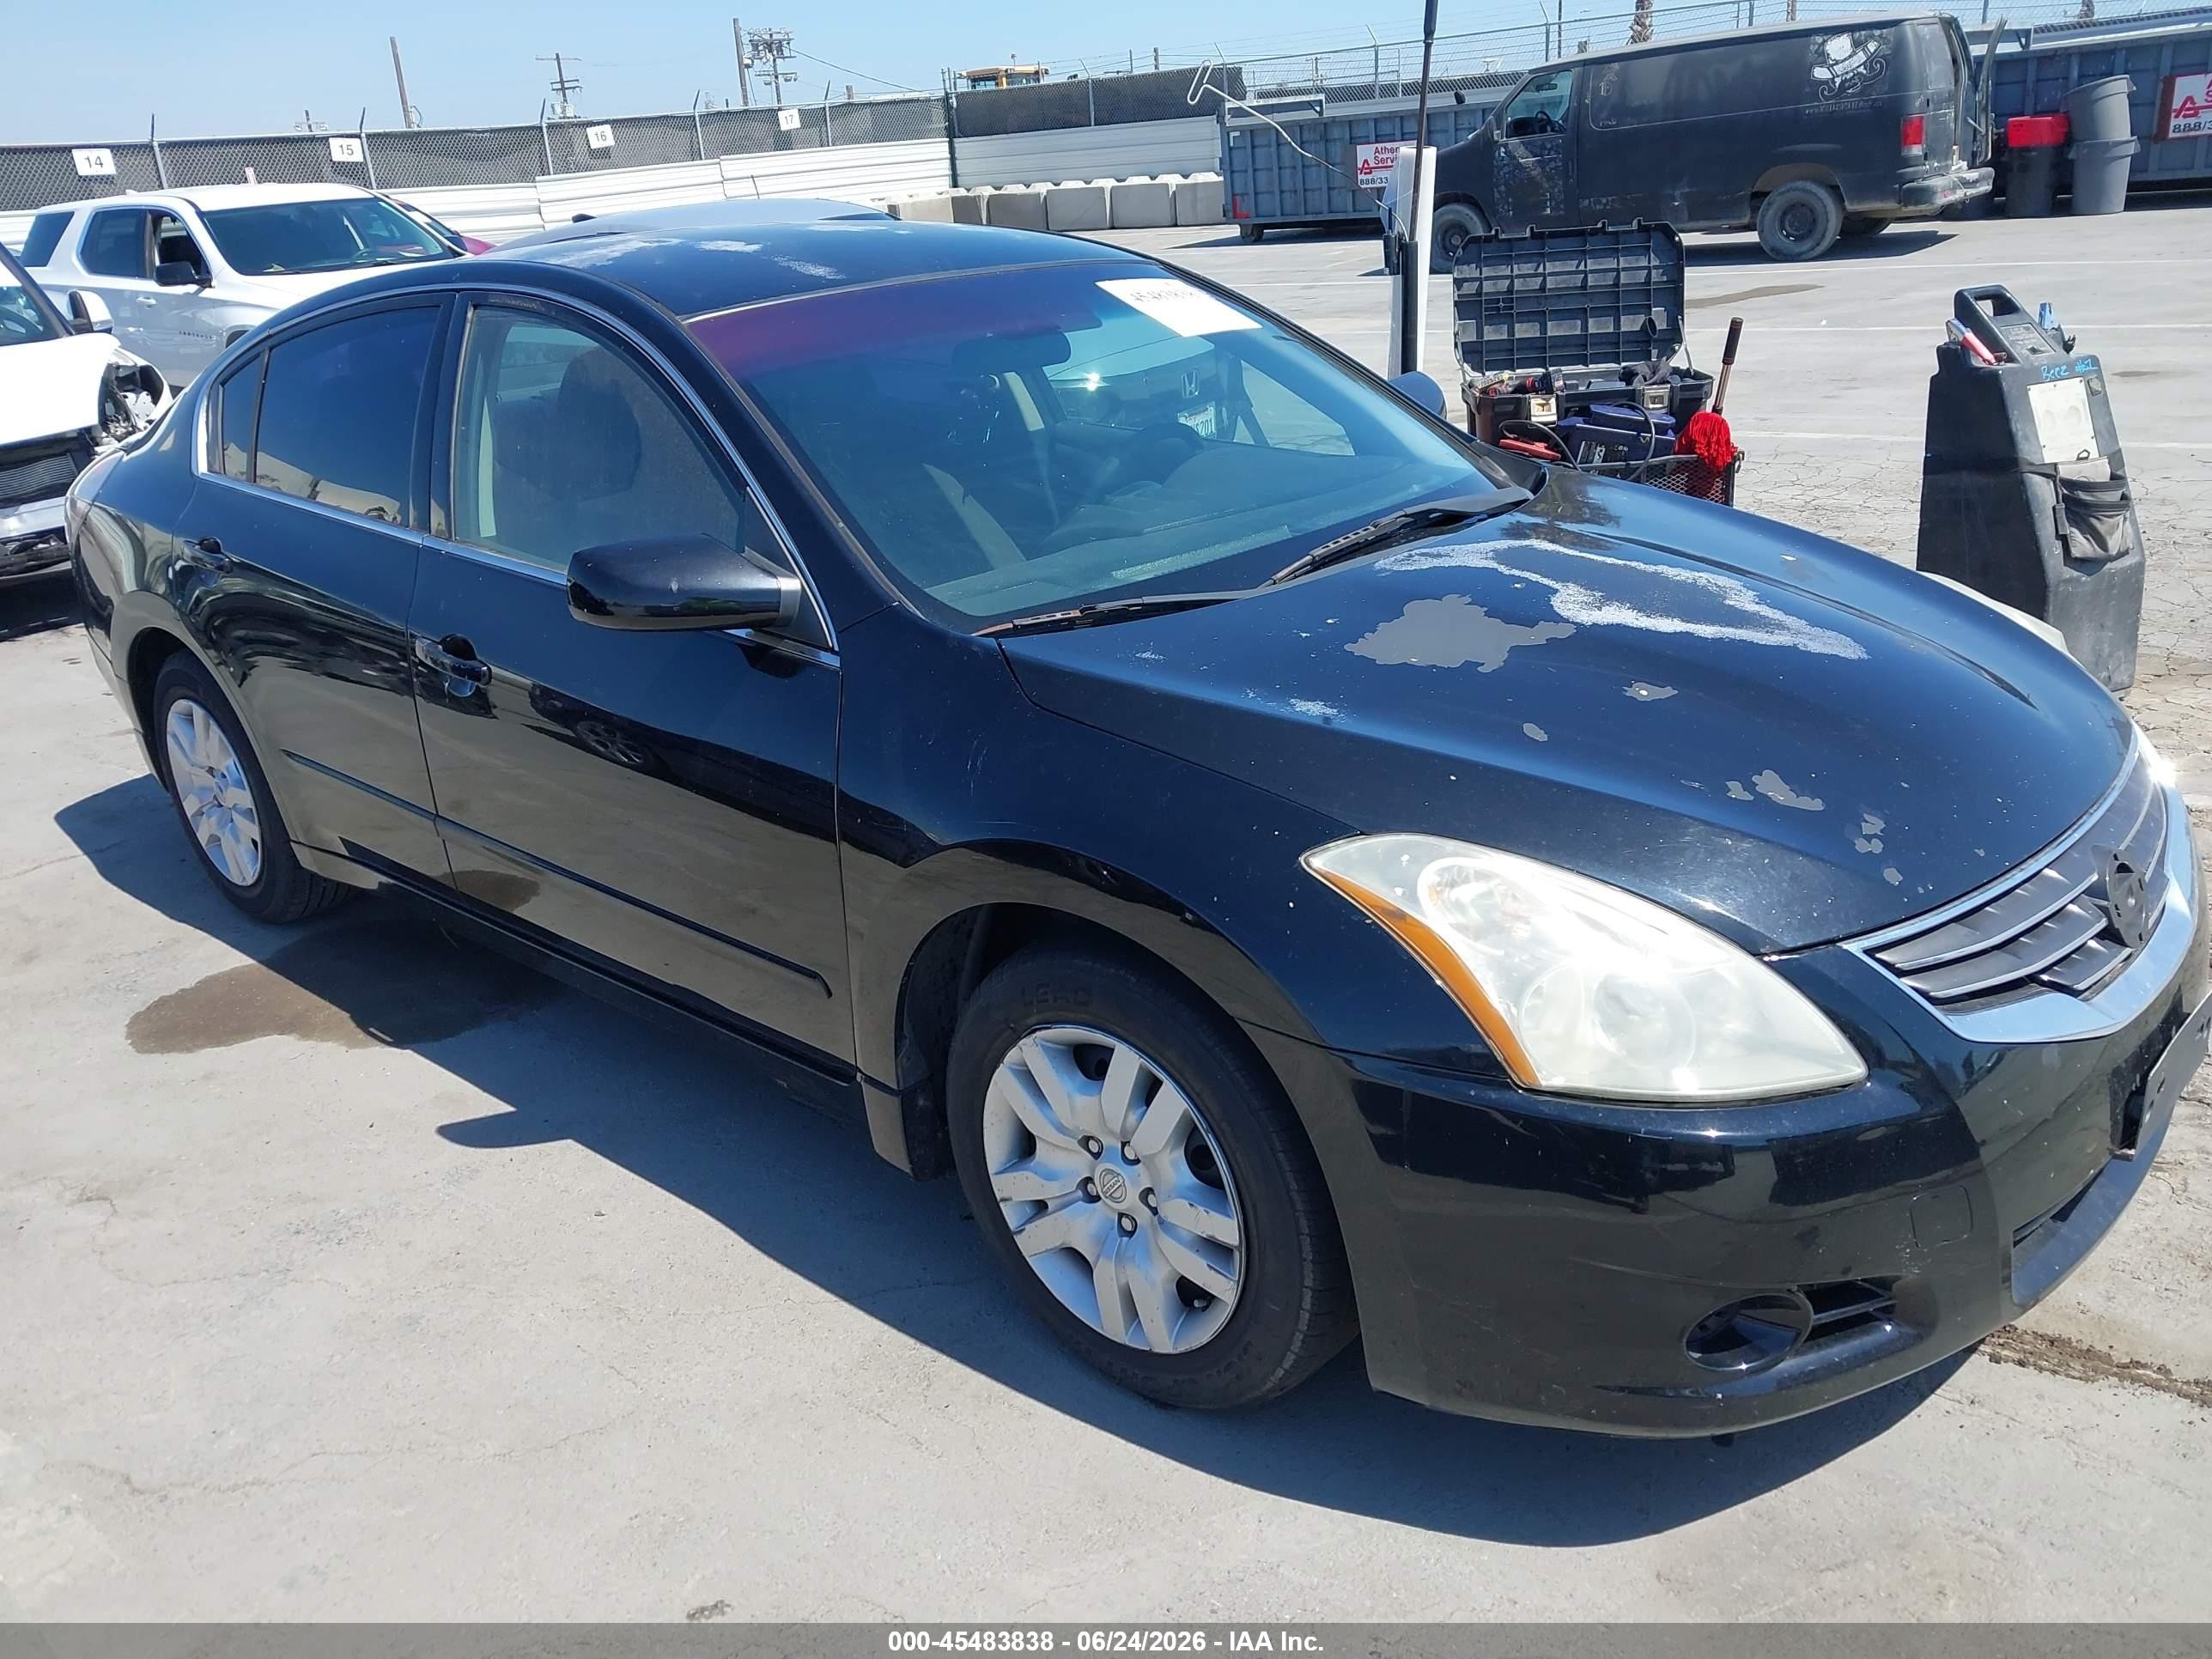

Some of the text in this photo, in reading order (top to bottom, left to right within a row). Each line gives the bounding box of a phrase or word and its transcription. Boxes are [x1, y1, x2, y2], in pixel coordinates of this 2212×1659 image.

[785, 114, 794, 125] 17
[594, 131, 606, 142] 16
[339, 144, 354, 155] 15
[84, 155, 103, 168] 14
